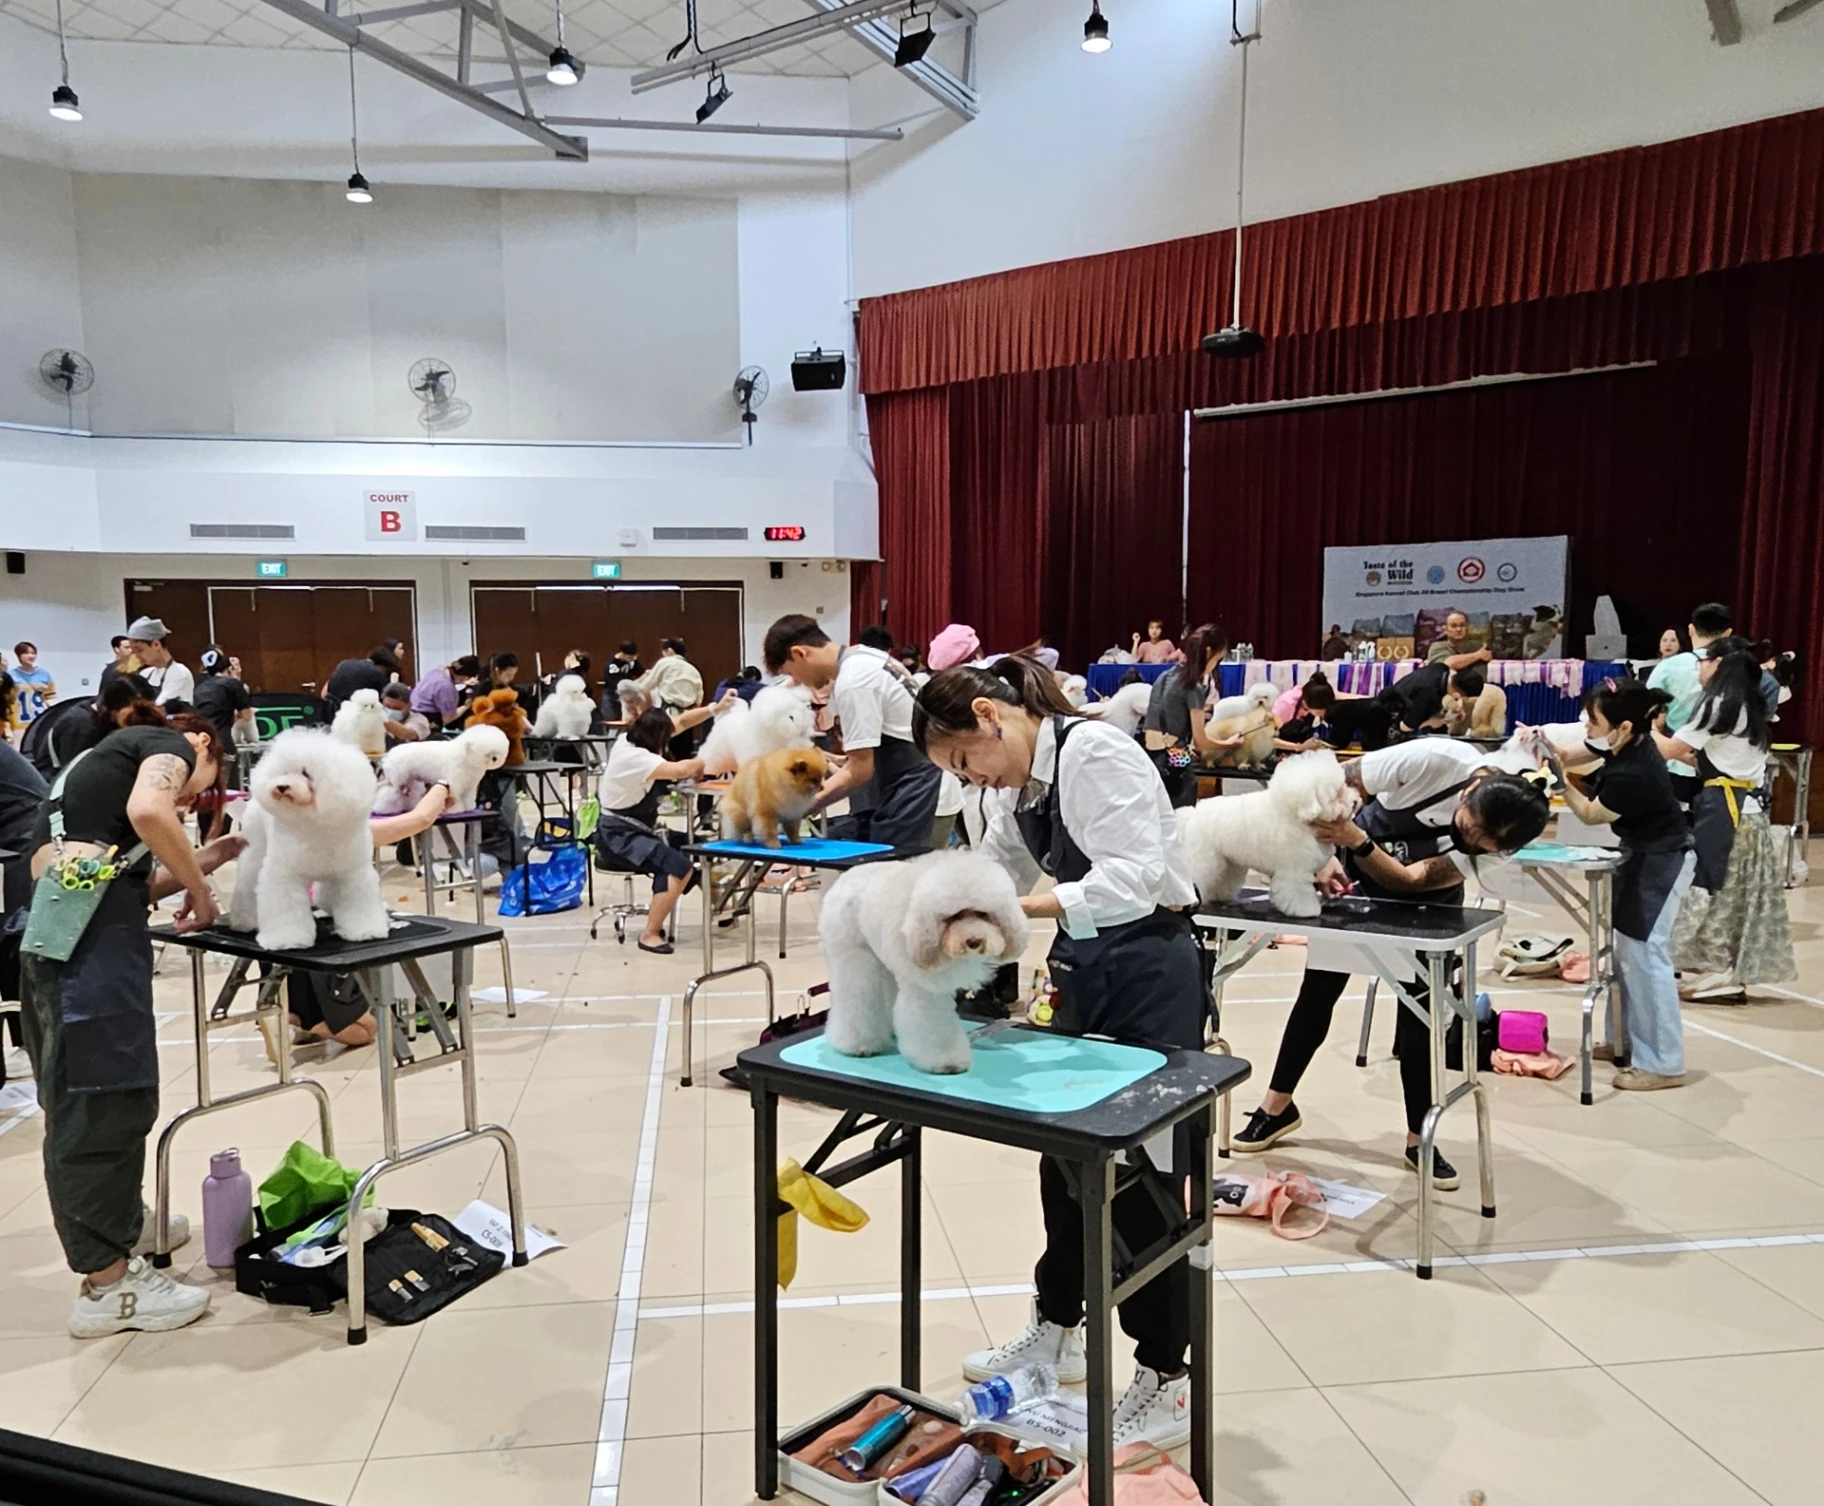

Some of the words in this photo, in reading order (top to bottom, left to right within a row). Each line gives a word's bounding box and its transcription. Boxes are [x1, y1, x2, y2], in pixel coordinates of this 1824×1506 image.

[370, 494, 409, 503] COURT
[380, 511, 401, 532] B
[261, 563, 281, 574] EXIT
[1363, 561, 1385, 569] Taste
[1388, 560, 1397, 568] of
[1399, 559, 1413, 568] the
[597, 565, 615, 576] EXIT
[1387, 569, 1414, 580] Wild
[116, 1291, 138, 1320] B
